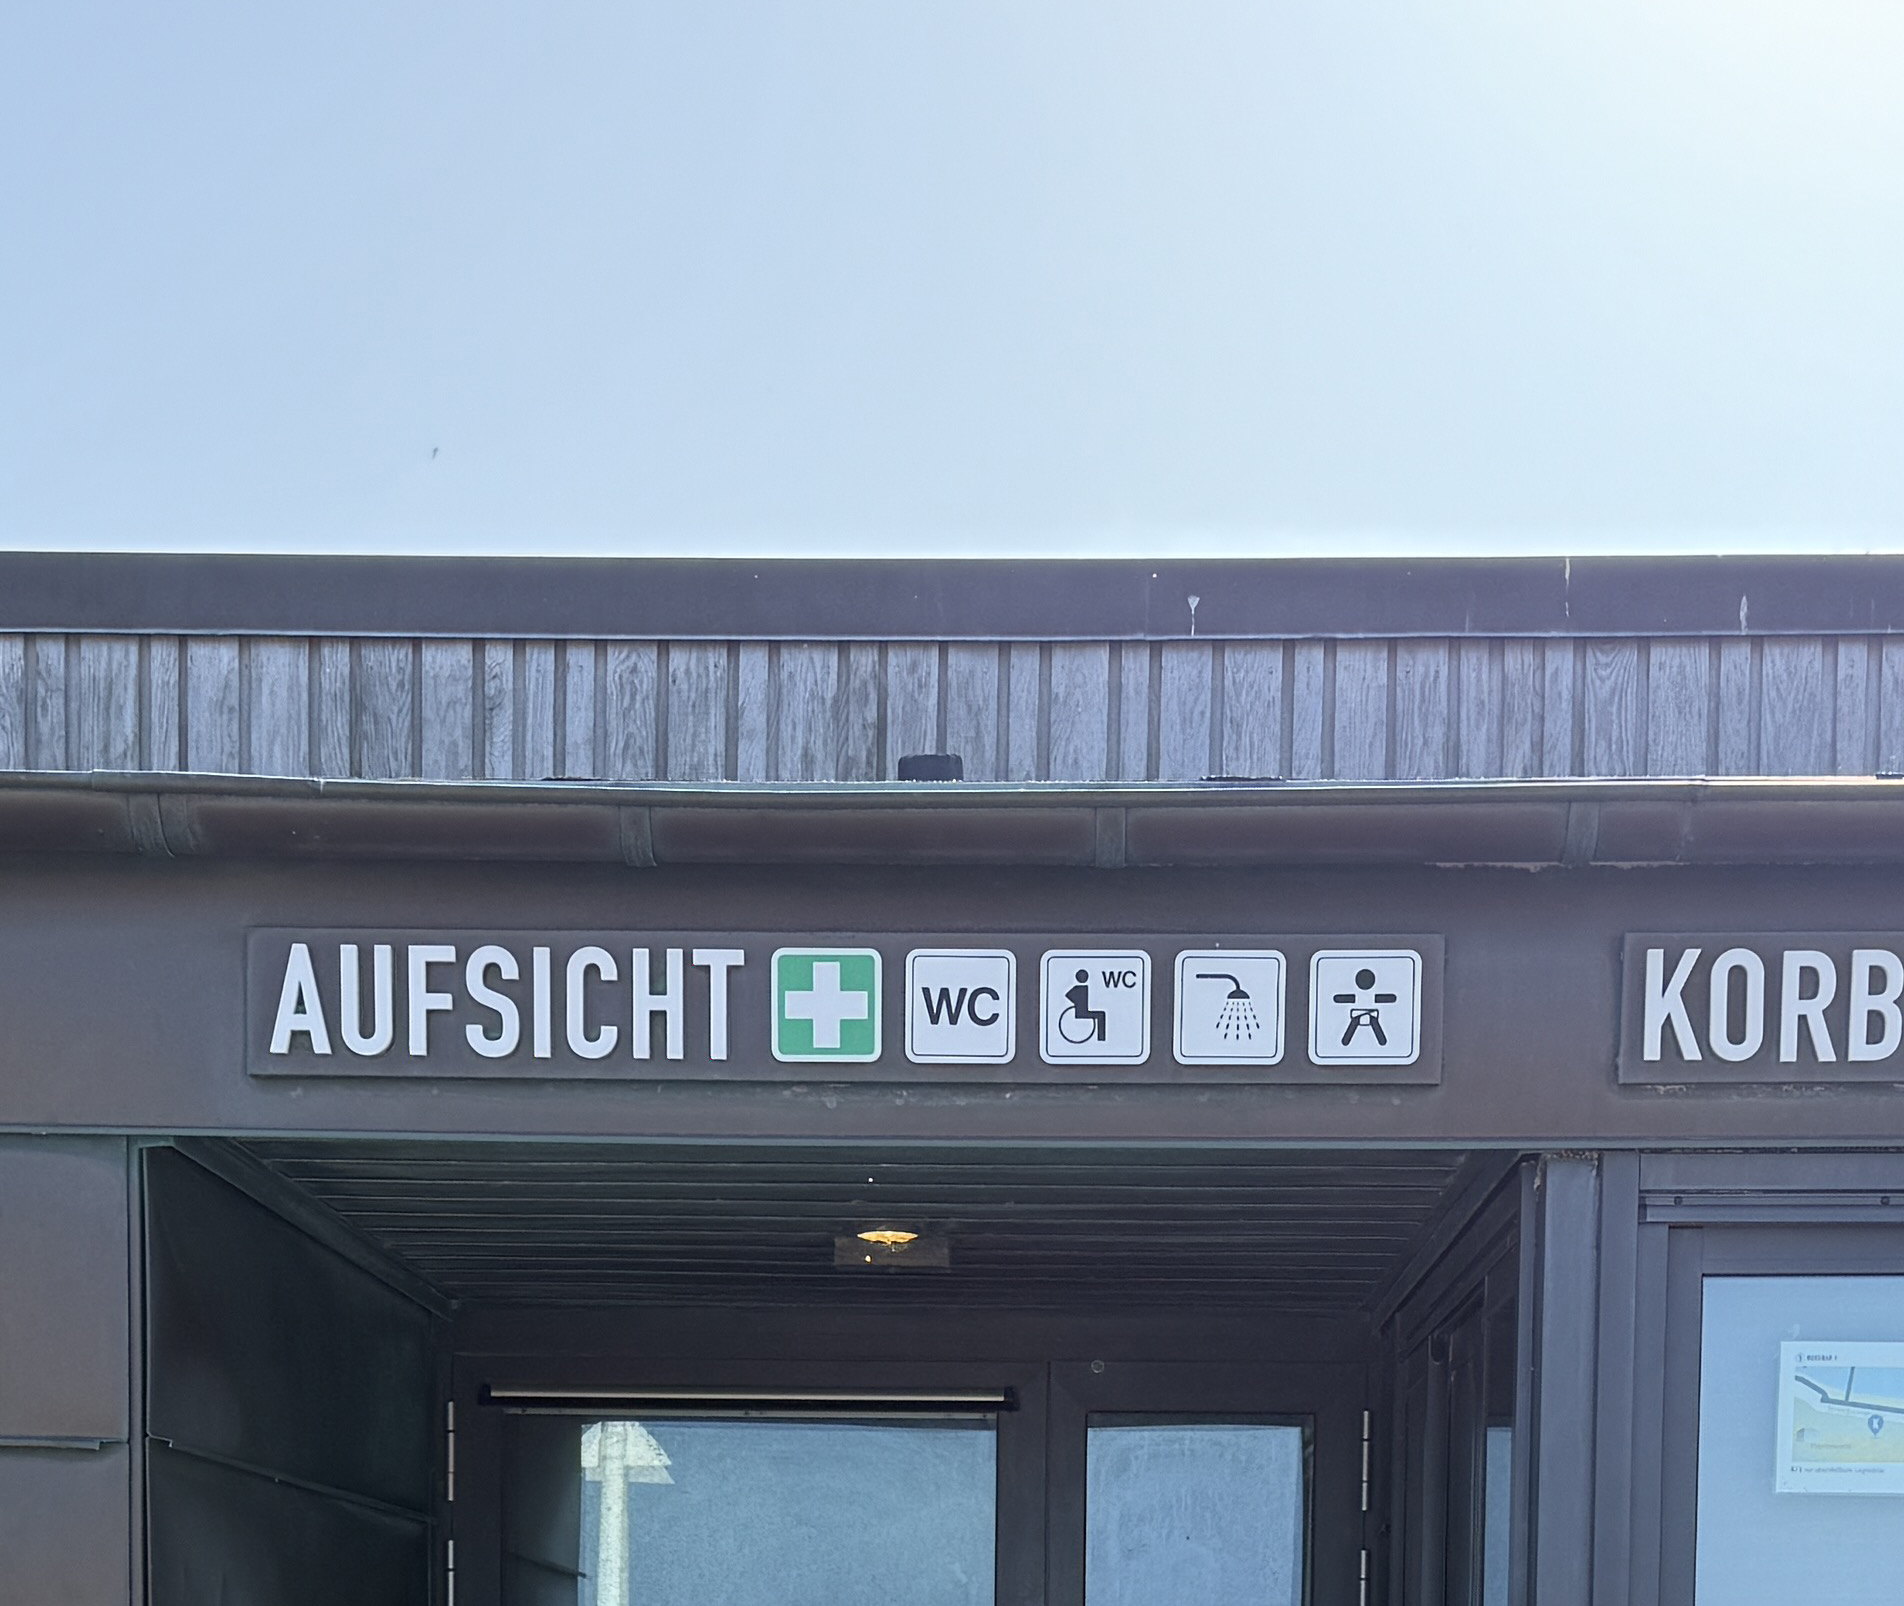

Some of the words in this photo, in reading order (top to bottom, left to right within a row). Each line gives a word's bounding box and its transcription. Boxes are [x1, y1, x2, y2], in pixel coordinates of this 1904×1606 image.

[1101, 970, 1137, 990] WC
[269, 942, 745, 1061] AUFSICHT
[921, 986, 1000, 1027] WC
